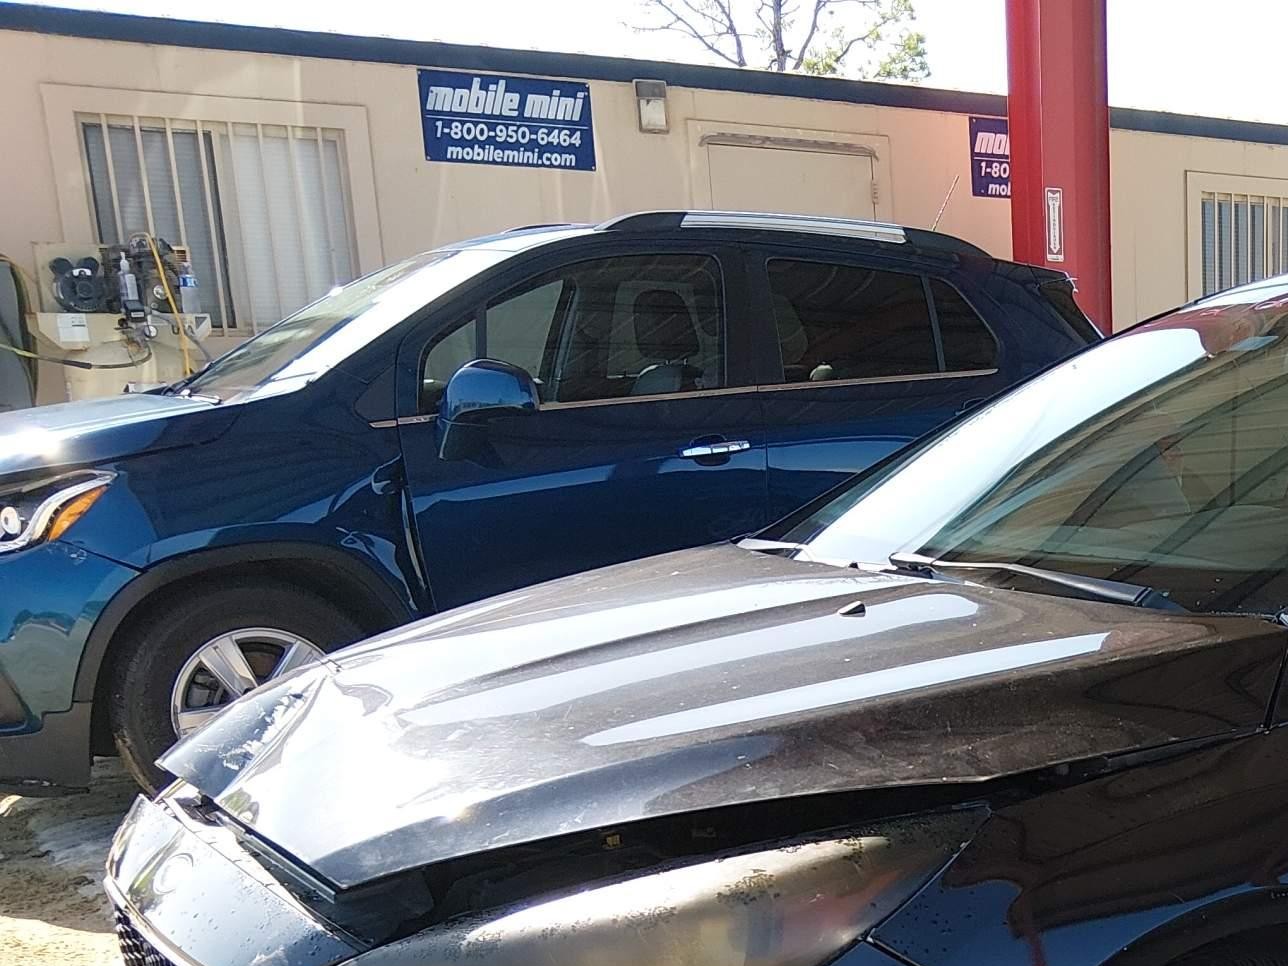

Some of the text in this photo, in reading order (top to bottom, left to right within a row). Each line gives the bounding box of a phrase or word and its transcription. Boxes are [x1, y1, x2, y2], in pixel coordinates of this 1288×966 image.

[426, 78, 584, 121] mobile mini
[435, 121, 581, 147] 1-800-950-6464
[447, 145, 576, 167] mobilemini.com
[980, 161, 1010, 179] 1-80
